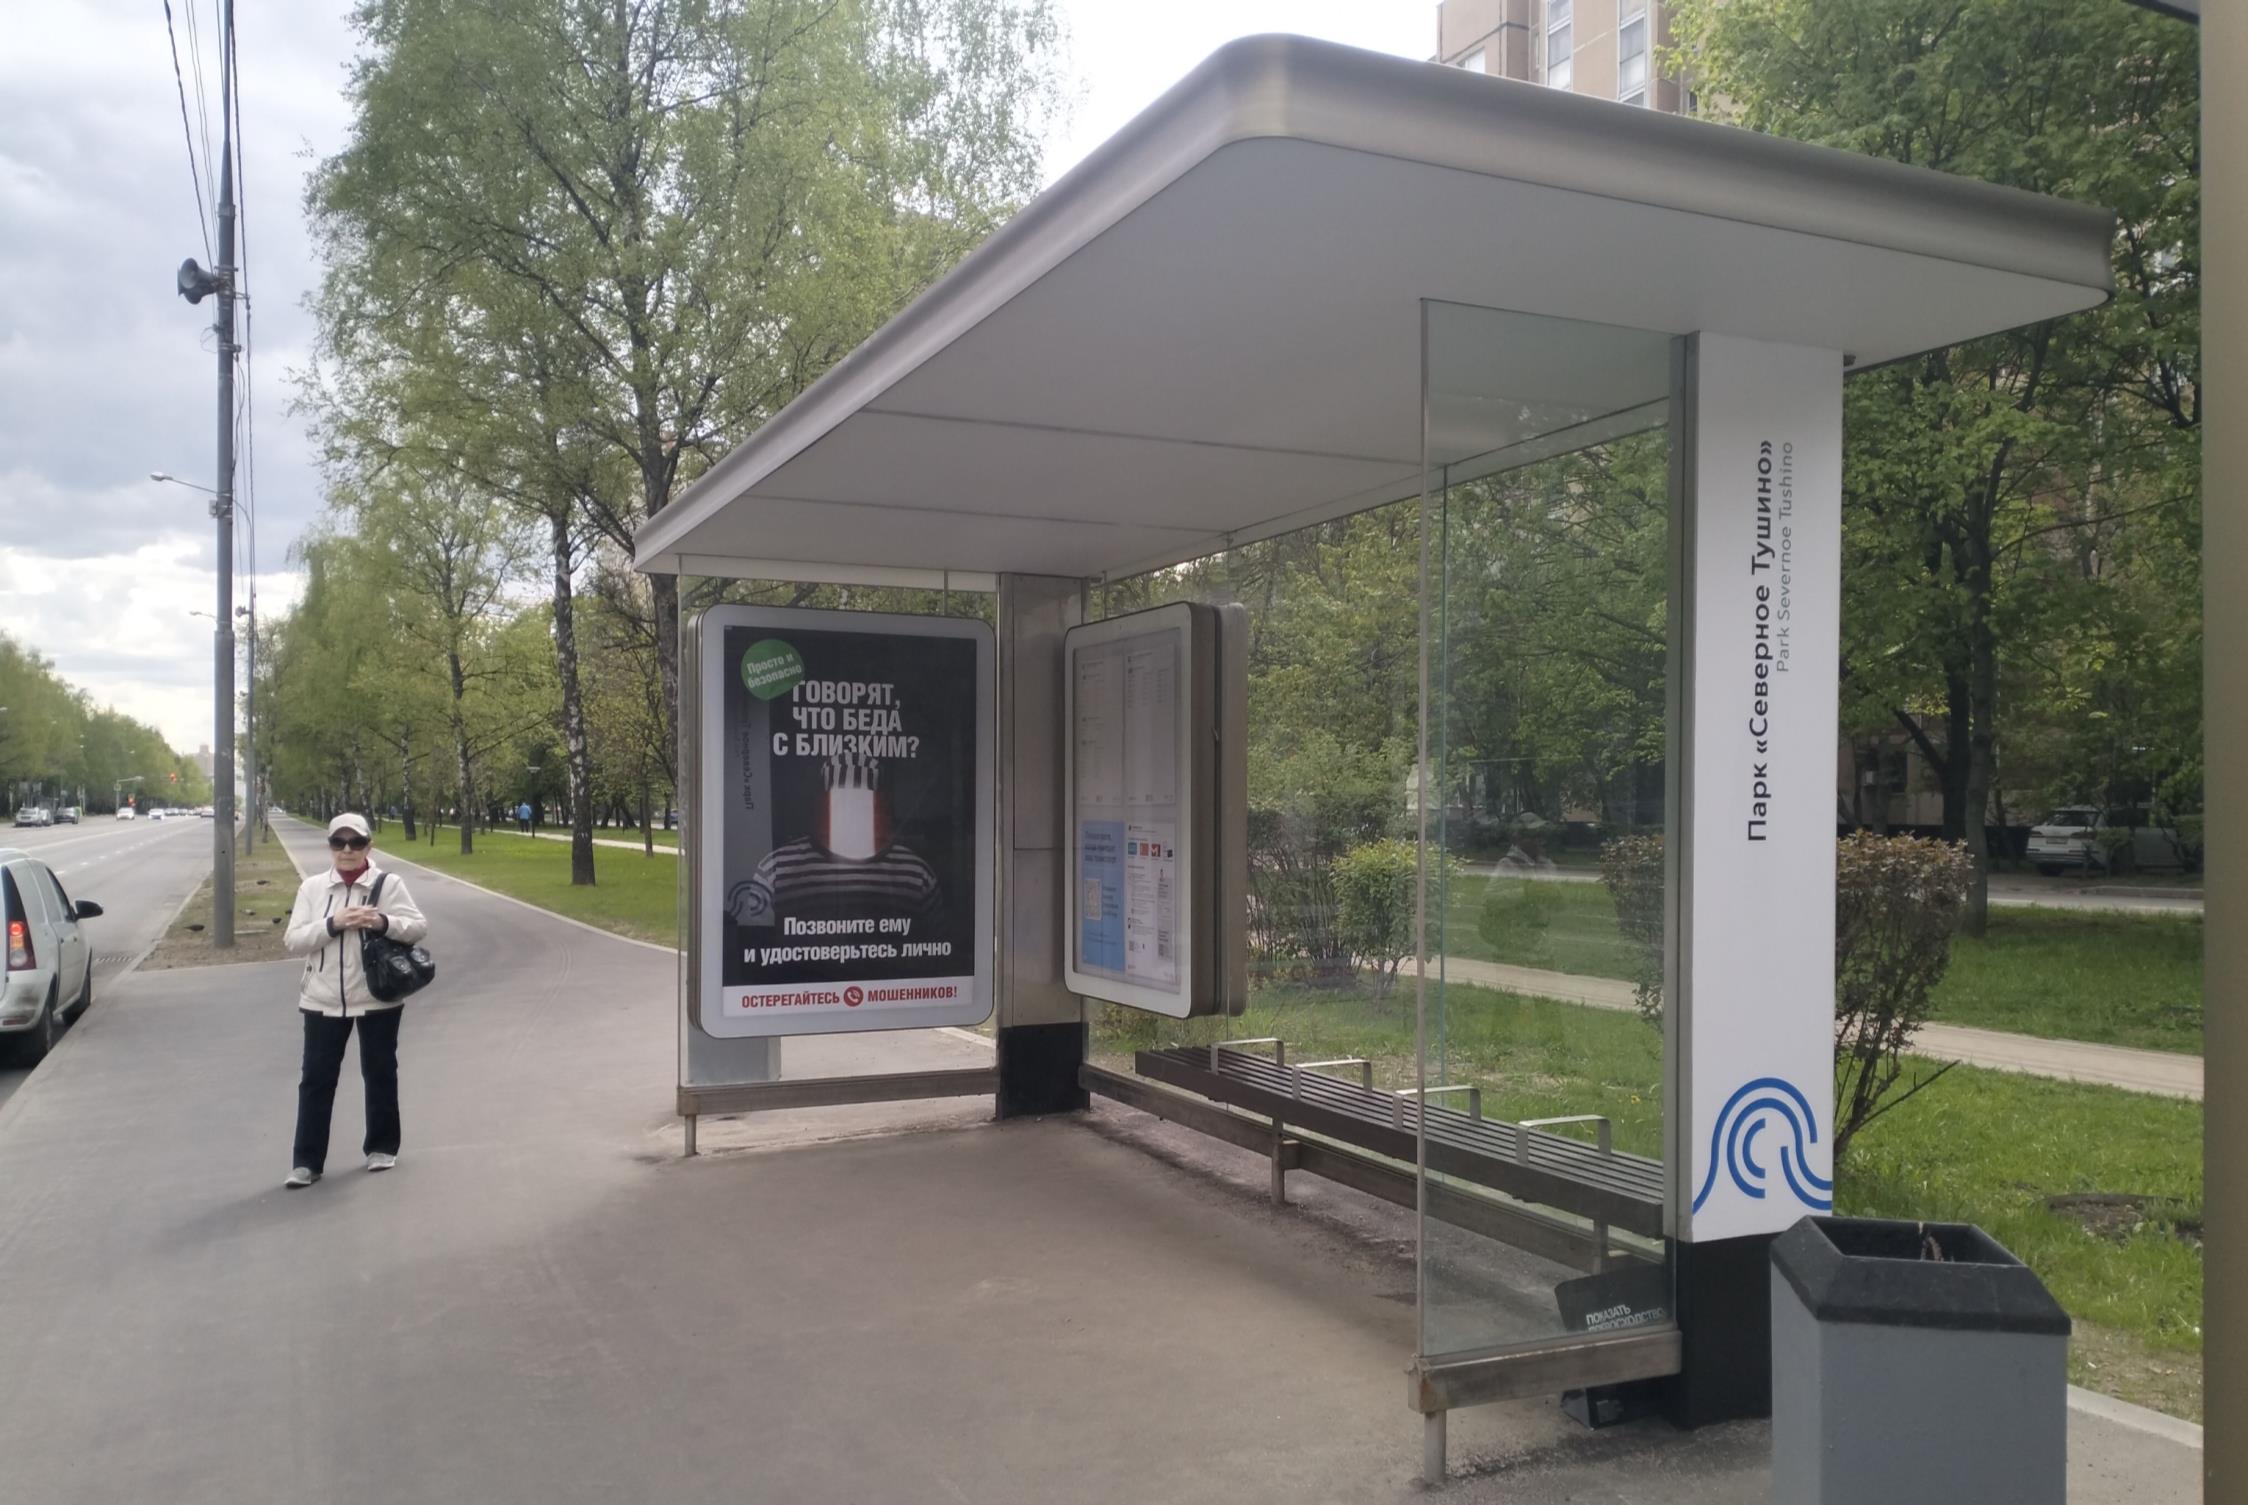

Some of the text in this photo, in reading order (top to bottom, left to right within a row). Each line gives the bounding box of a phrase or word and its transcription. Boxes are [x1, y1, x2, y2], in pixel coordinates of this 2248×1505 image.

[1776, 441, 1794, 672] Park Severnoe Tushino
[1747, 439, 1776, 841] Парк «Северное Тушино»
[747, 653, 794, 675] Просто и
[748, 664, 802, 688] безопасно
[792, 680, 901, 709] ГОВОРЯТ,
[792, 706, 902, 736] ЧТО БЕДА
[773, 732, 920, 759] С БЛИЗКИМ?
[783, 916, 911, 936] Позвоните ему
[744, 940, 952, 967] и удостоверьтесь лично
[741, 986, 958, 1008] ОСТЕРЕГАЙТЕСЬ МОШЕННИКОВ!
[1586, 1304, 1632, 1326] ПОКАЗАТЬ
